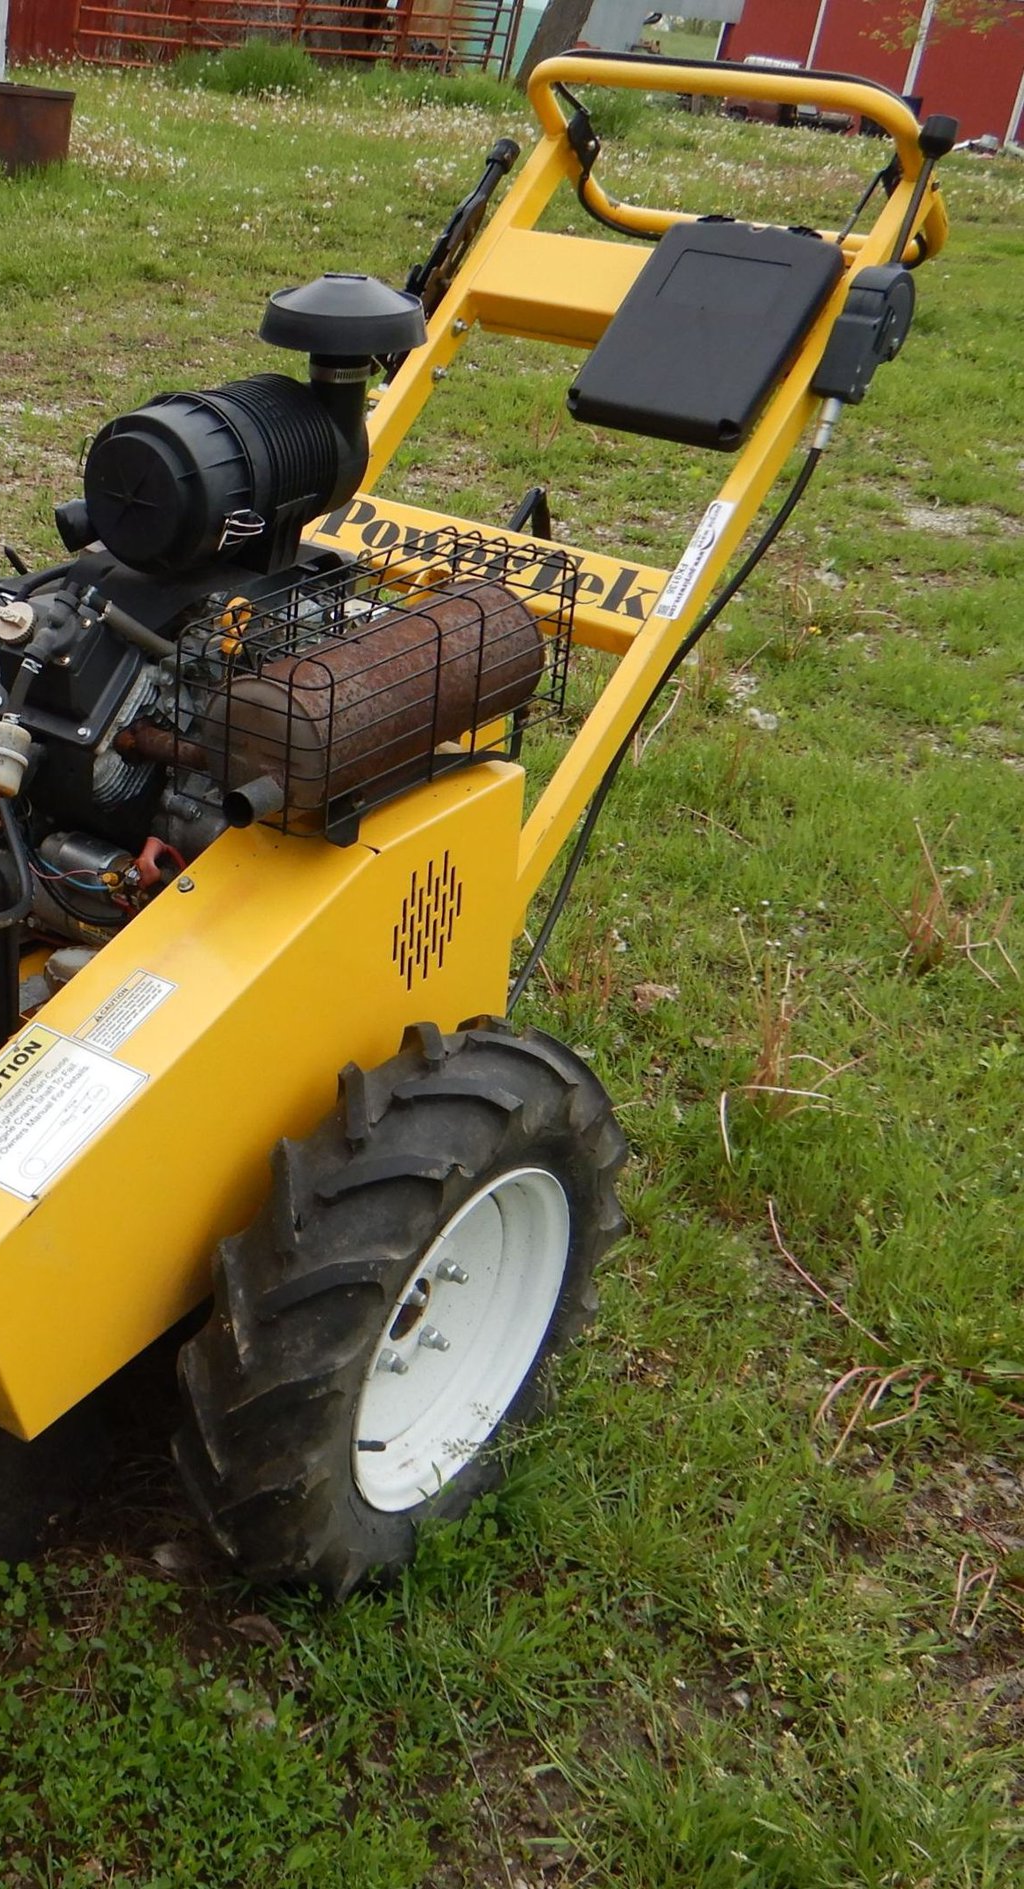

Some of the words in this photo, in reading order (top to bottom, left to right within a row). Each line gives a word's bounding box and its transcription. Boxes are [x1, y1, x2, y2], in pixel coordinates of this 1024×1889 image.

[316, 498, 658, 621] PowerTek
[665, 551, 707, 616] www.purplewave.com
[98, 987, 129, 1015] CAUTION
[28, 1078, 47, 1094] Can
[43, 1055, 69, 1079] Cause
[12, 1103, 37, 1126] Crank
[33, 1084, 56, 1104] Shaft
[51, 1075, 64, 1085] To
[25, 1100, 54, 1127] Manual
[50, 1088, 66, 1101] For
